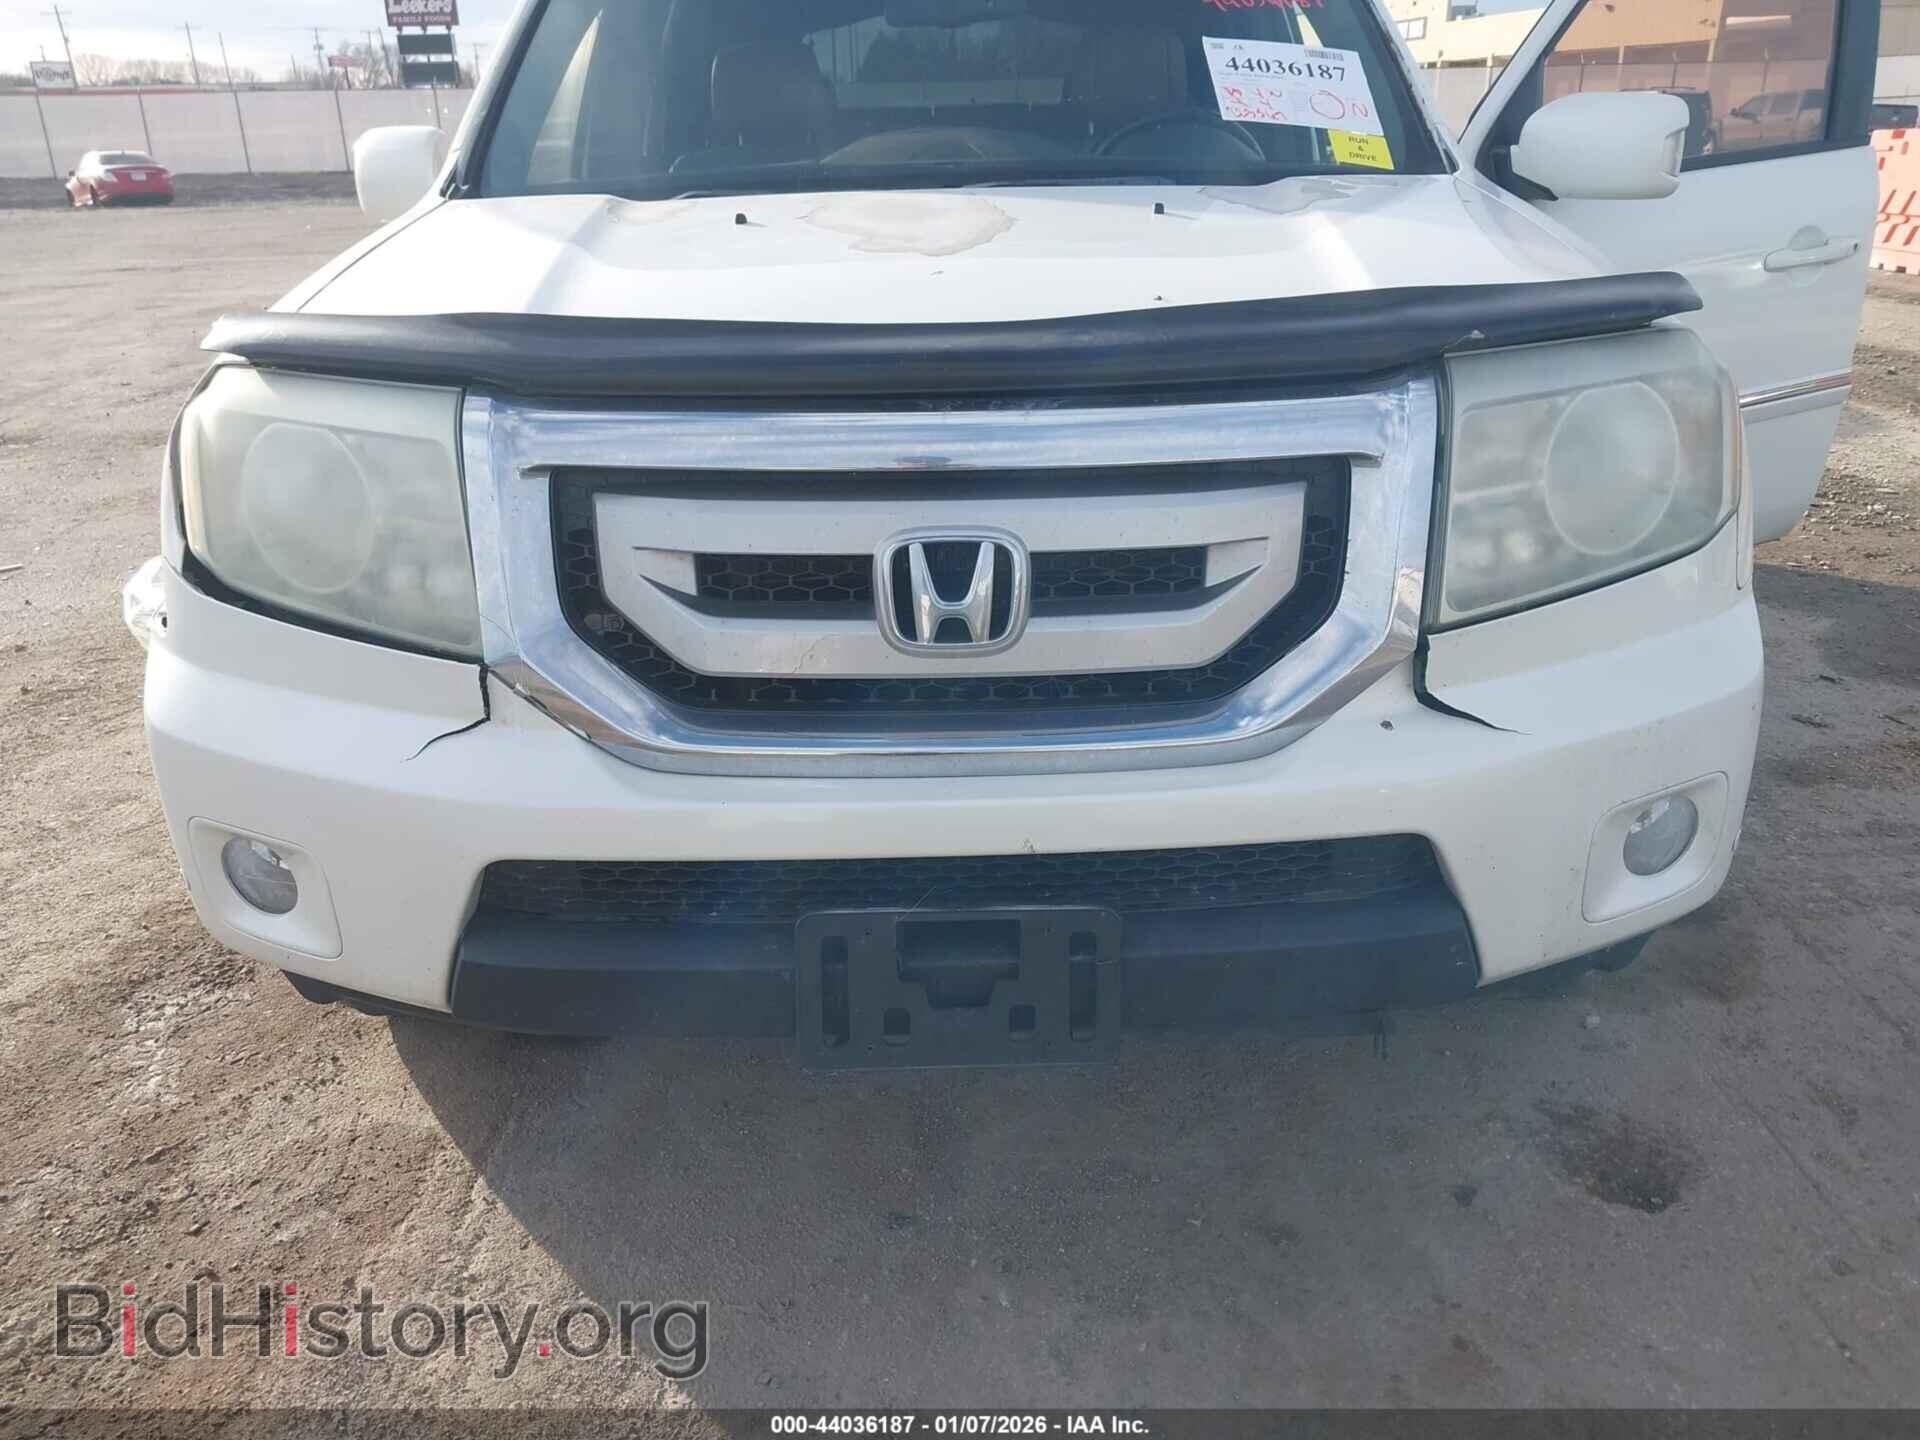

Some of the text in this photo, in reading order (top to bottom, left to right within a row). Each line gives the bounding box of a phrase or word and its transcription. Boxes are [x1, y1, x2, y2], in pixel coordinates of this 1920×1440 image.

[1225, 55, 1346, 82] 44036187
[1348, 135, 1369, 145] RUN
[1349, 152, 1377, 162] DRIVE
